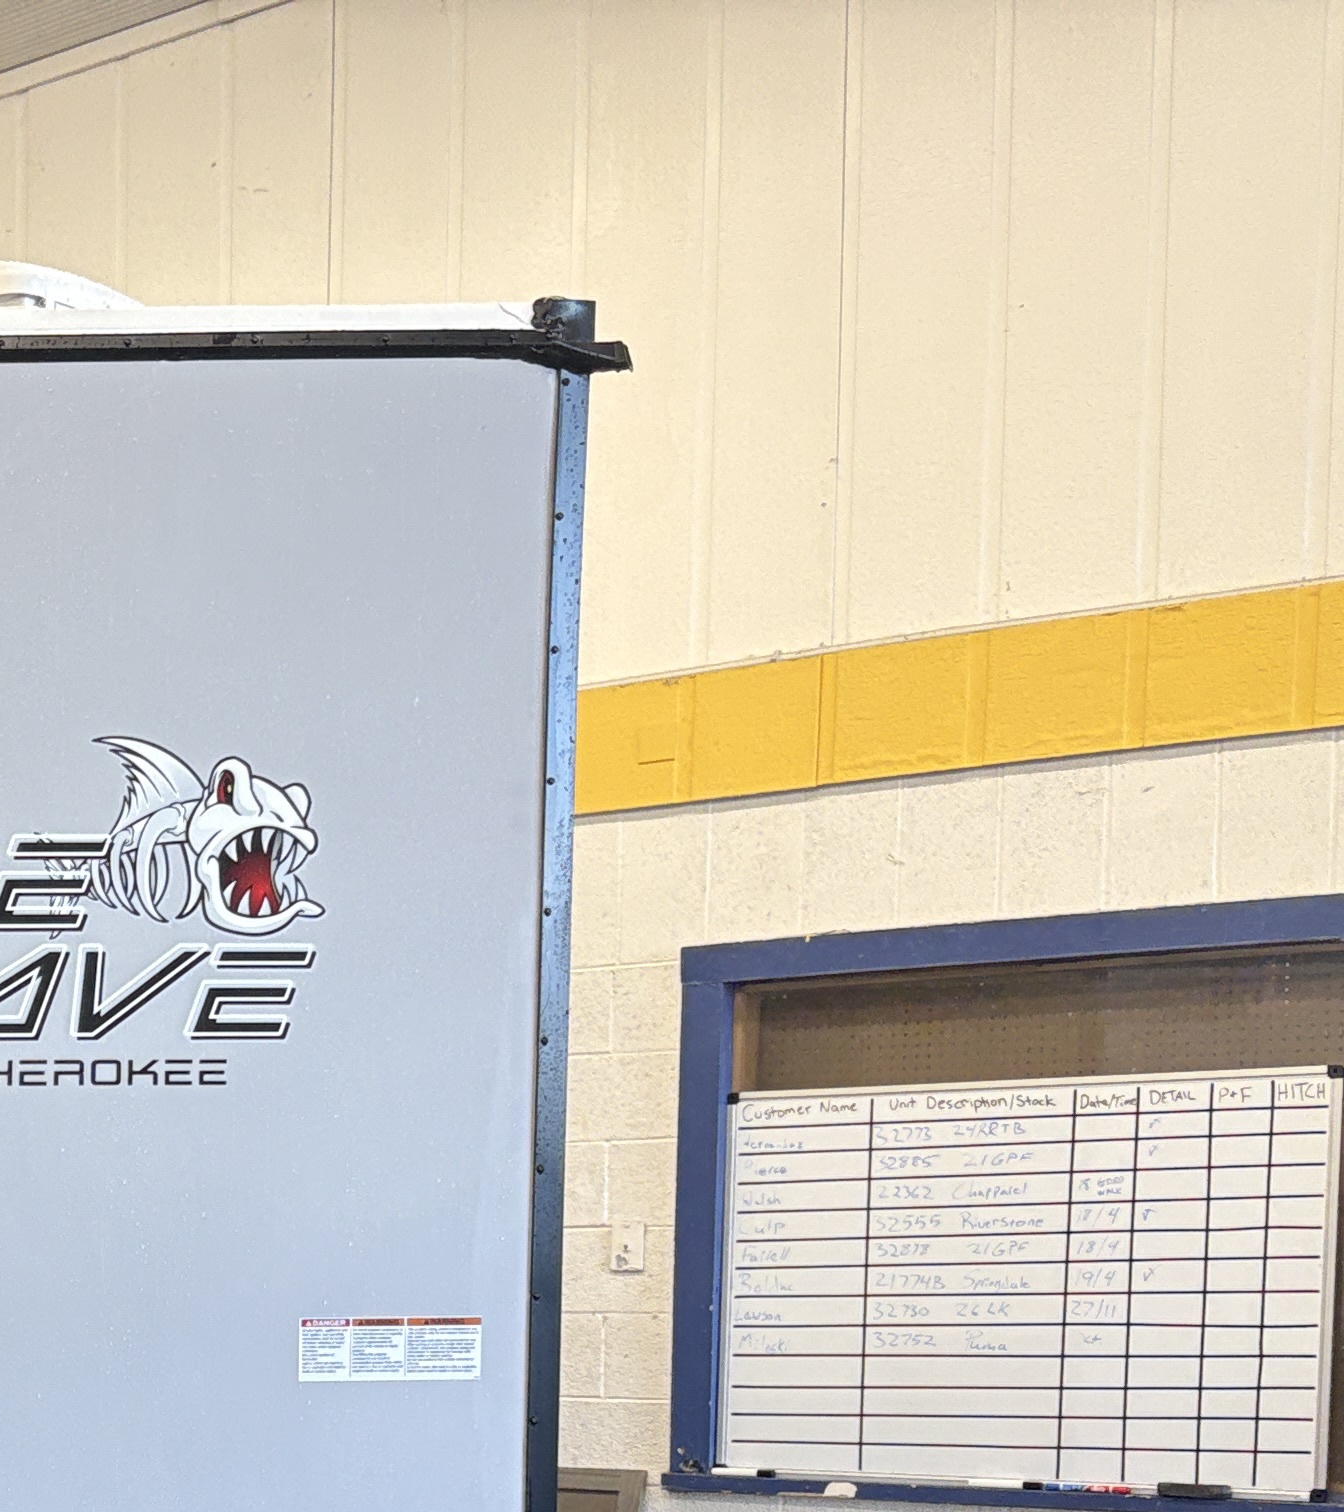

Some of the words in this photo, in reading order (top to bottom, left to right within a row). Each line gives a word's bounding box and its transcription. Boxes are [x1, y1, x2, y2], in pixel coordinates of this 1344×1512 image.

[1149, 1089, 1196, 1105] DETAIL
[1278, 1082, 1326, 1100] HITCH
[742, 1103, 812, 1122] Customer
[820, 1099, 857, 1113] Name
[889, 1097, 916, 1110] Unit
